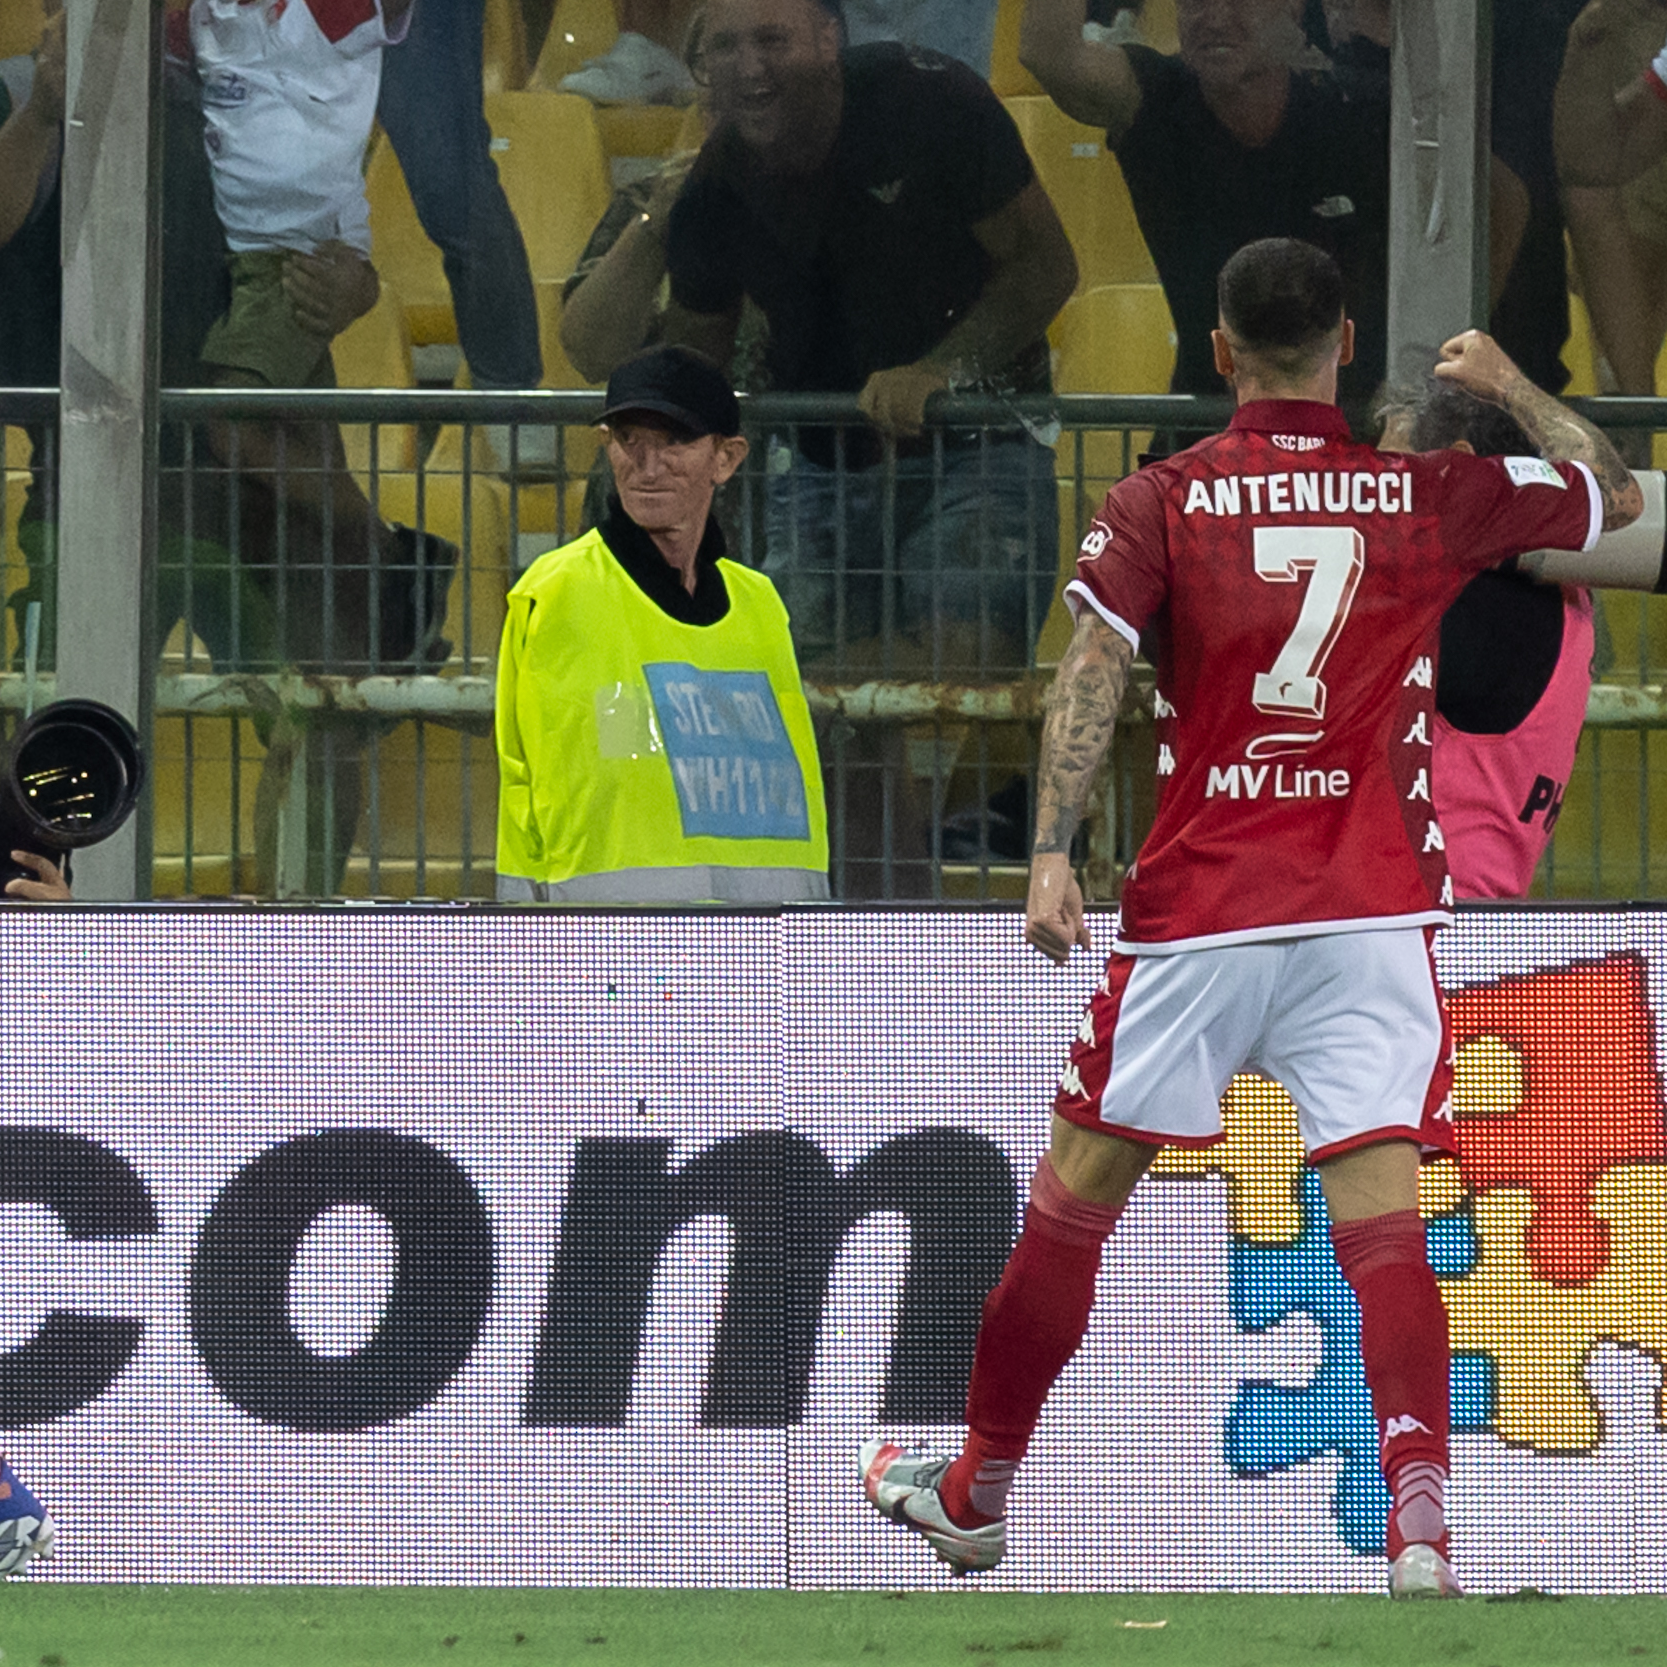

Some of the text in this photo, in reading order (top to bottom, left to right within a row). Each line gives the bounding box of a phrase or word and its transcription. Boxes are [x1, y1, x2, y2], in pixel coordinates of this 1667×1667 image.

[1183, 471, 1413, 516] ANTENUCCI
[1251, 526, 1365, 720] 7
[1205, 762, 1351, 799] MV Line
